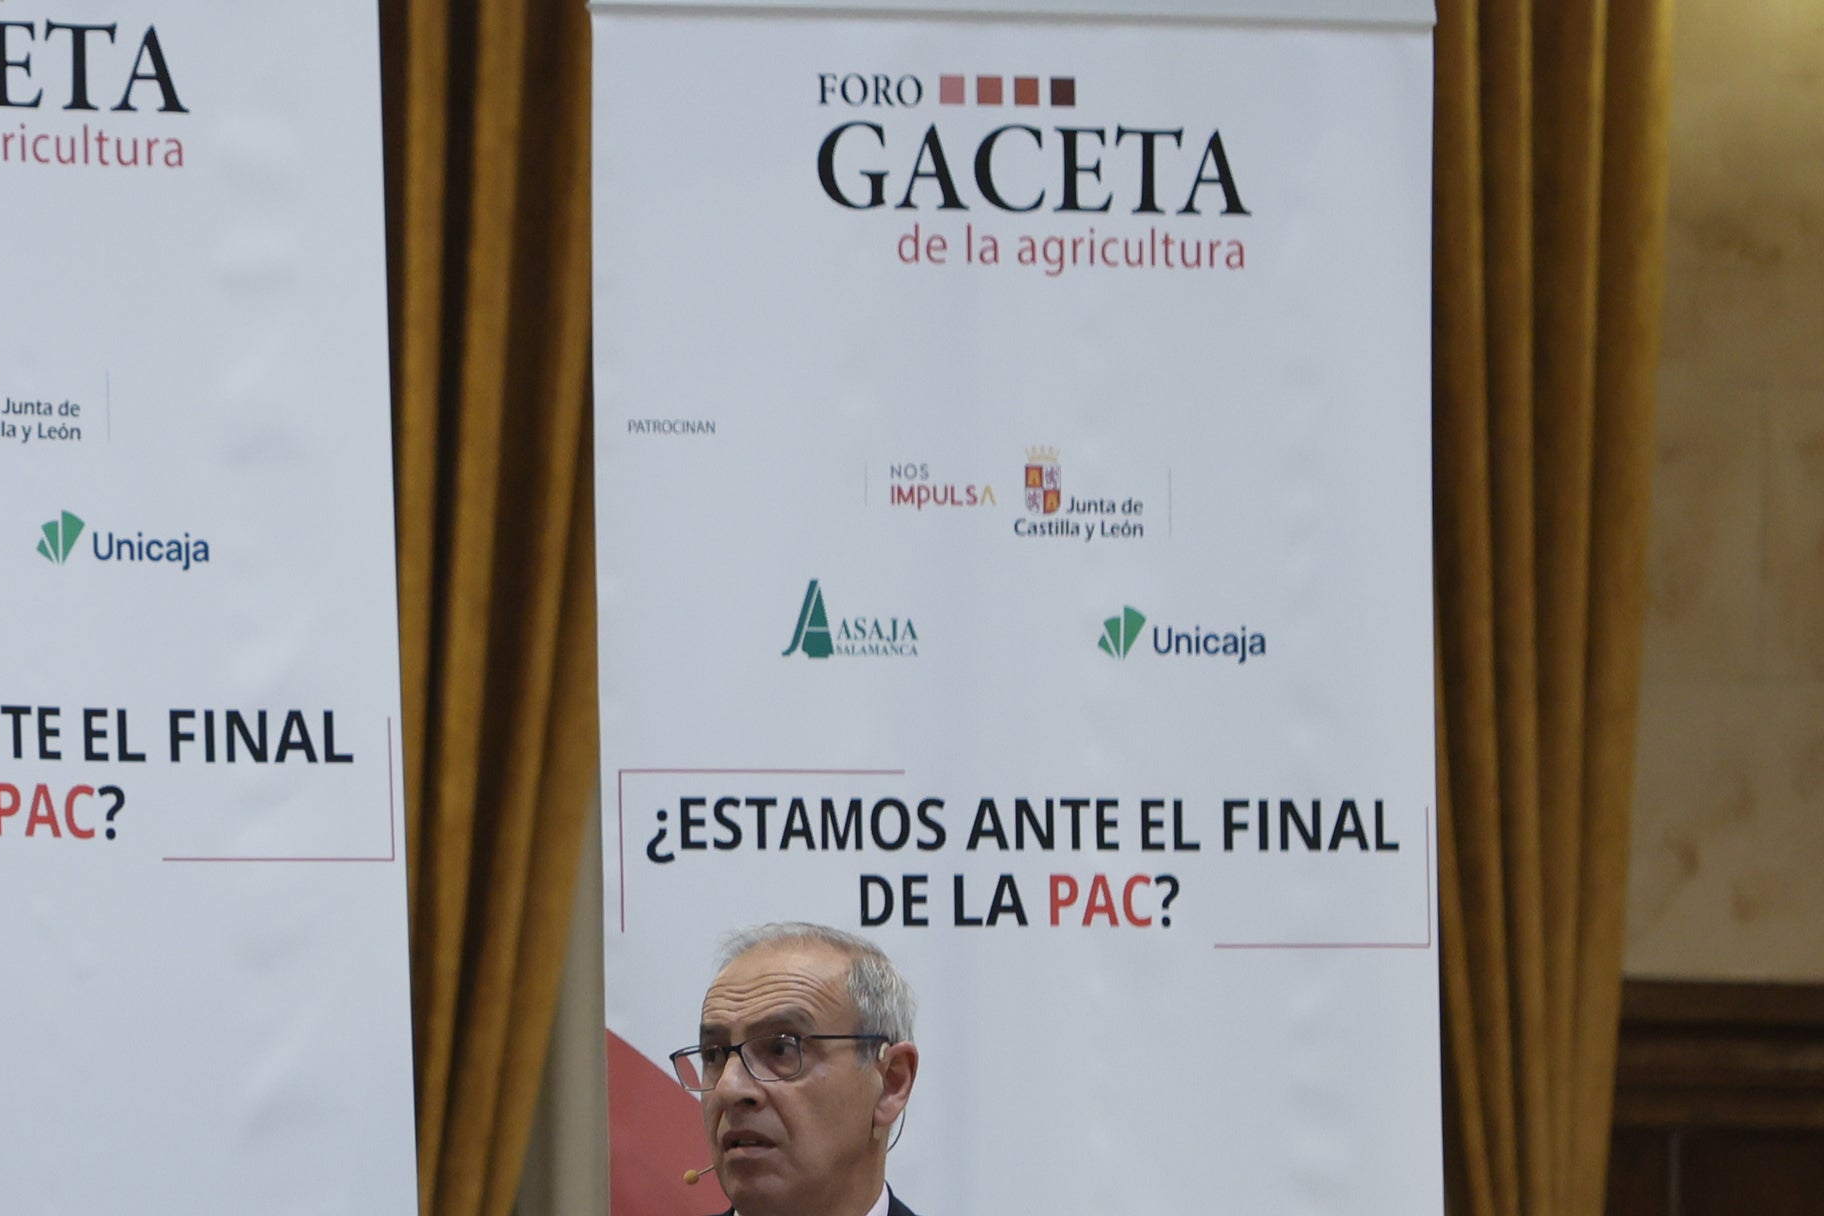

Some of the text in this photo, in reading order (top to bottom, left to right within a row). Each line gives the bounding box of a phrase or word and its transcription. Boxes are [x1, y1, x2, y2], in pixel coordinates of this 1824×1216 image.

[819, 75, 923, 106] FORO
[817, 121, 1251, 215] GACETA
[898, 222, 1244, 276] de la agricultura
[2, 398, 80, 417] Junta de
[22, 426, 31, 443] y
[38, 422, 81, 440] León
[628, 419, 715, 434] PATROCINAN
[890, 463, 929, 480] NOS
[1067, 496, 1143, 514] Junta de
[1014, 519, 1143, 542] Castilla y León
[93, 532, 209, 571] Unicaja
[838, 618, 917, 642] ASAJA
[837, 642, 918, 656] SALAMANCA
[1154, 626, 1266, 664] Unicaja
[83, 708, 146, 762] EL
[169, 709, 353, 763] FINAL
[647, 797, 1399, 864] ¿ESTAMOS ANTE EL FINAL
[860, 874, 1179, 927] DE LA PAC?
